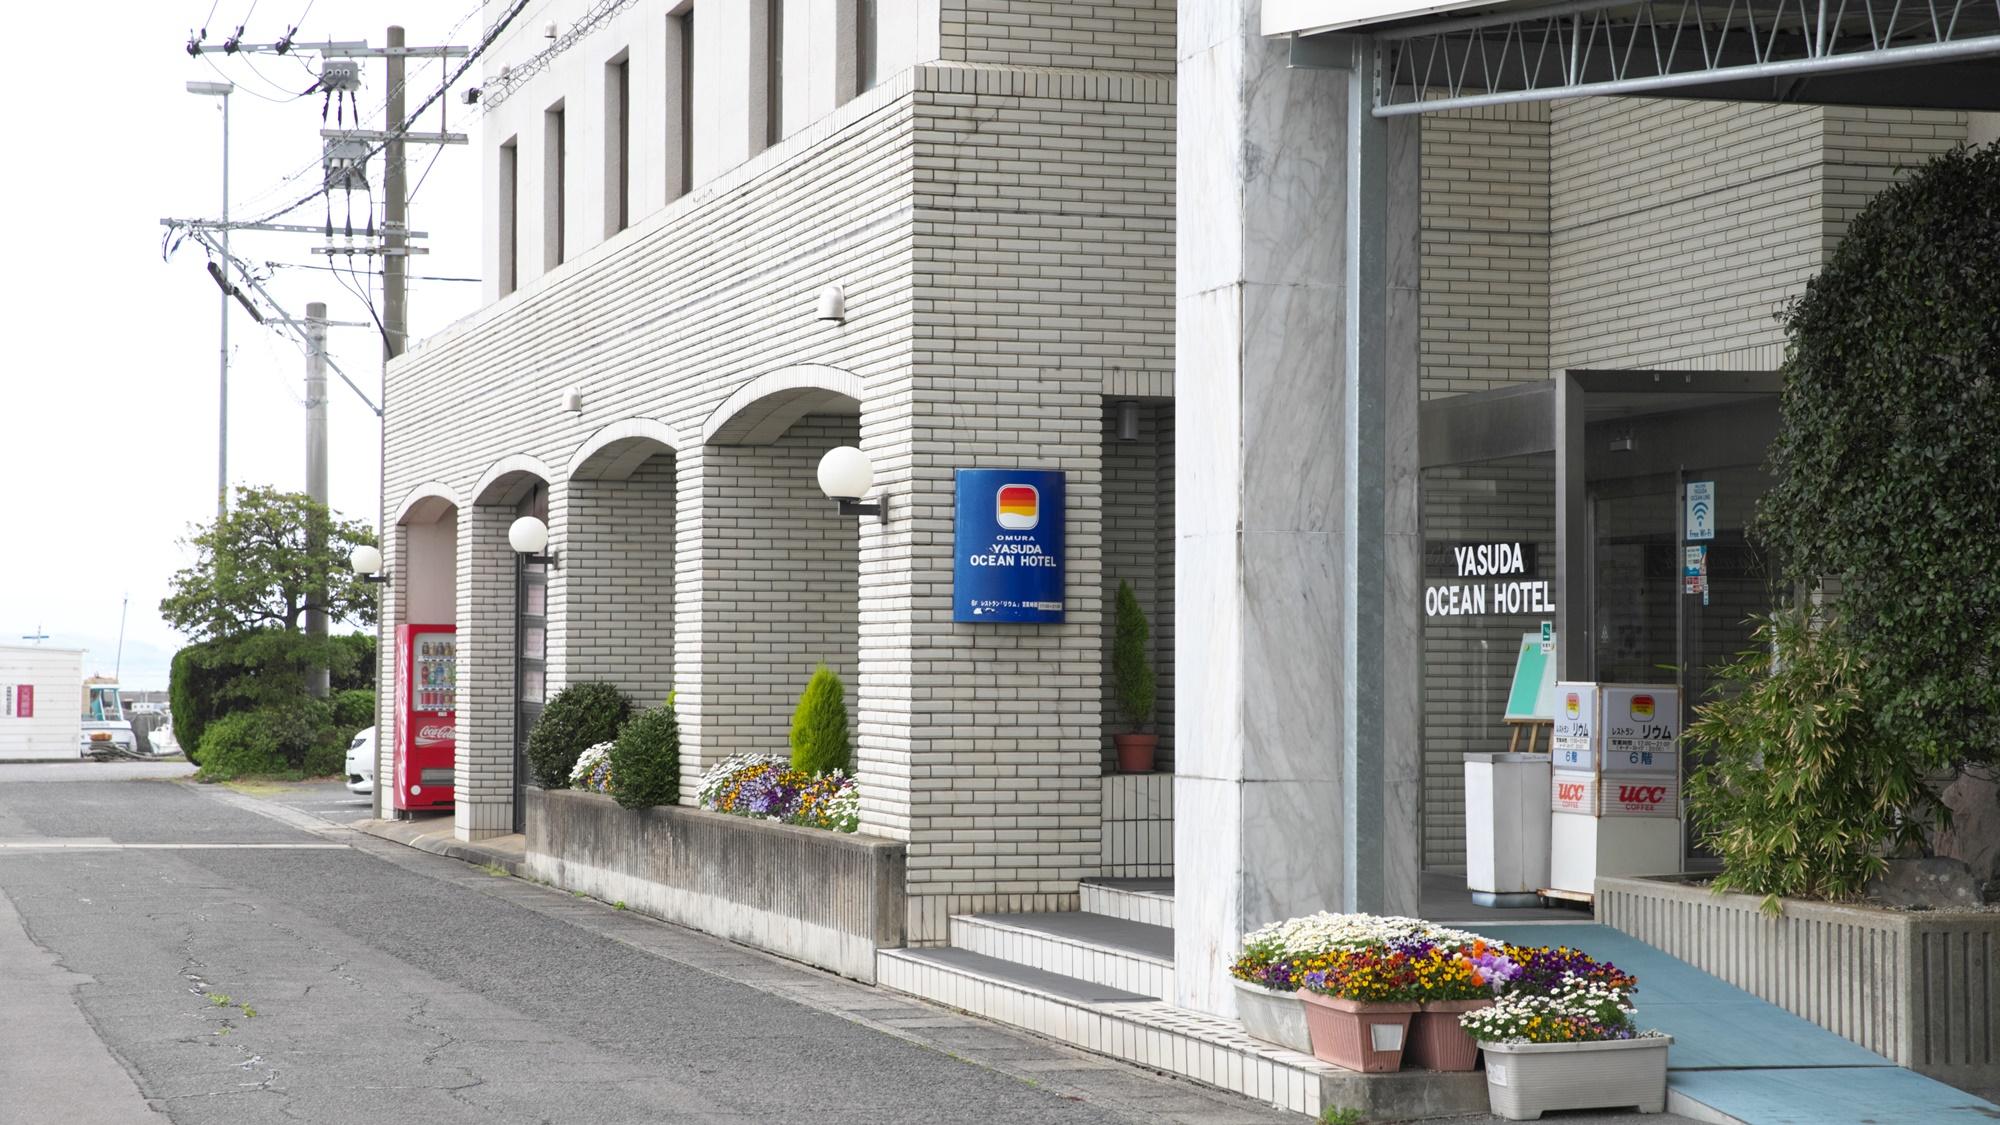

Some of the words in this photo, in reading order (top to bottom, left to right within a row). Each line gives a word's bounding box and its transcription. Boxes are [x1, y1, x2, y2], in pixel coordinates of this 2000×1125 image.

[992, 544, 1042, 554] YASUDA
[970, 555, 1015, 566] OCEAN
[1020, 556, 1056, 567] HOTEL
[1454, 542, 1524, 576] YASUDA
[1425, 584, 1485, 616] OCEAN
[1494, 581, 1555, 614] HOTEL
[1573, 722, 1588, 736] リウム
[1612, 727, 1634, 736] レストラン
[1642, 724, 1671, 739] リウム
[1630, 751, 1652, 765] 6階
[1558, 784, 1584, 800] UCC
[1619, 785, 1666, 803] UCC
[1626, 803, 1654, 811] COFFEE
